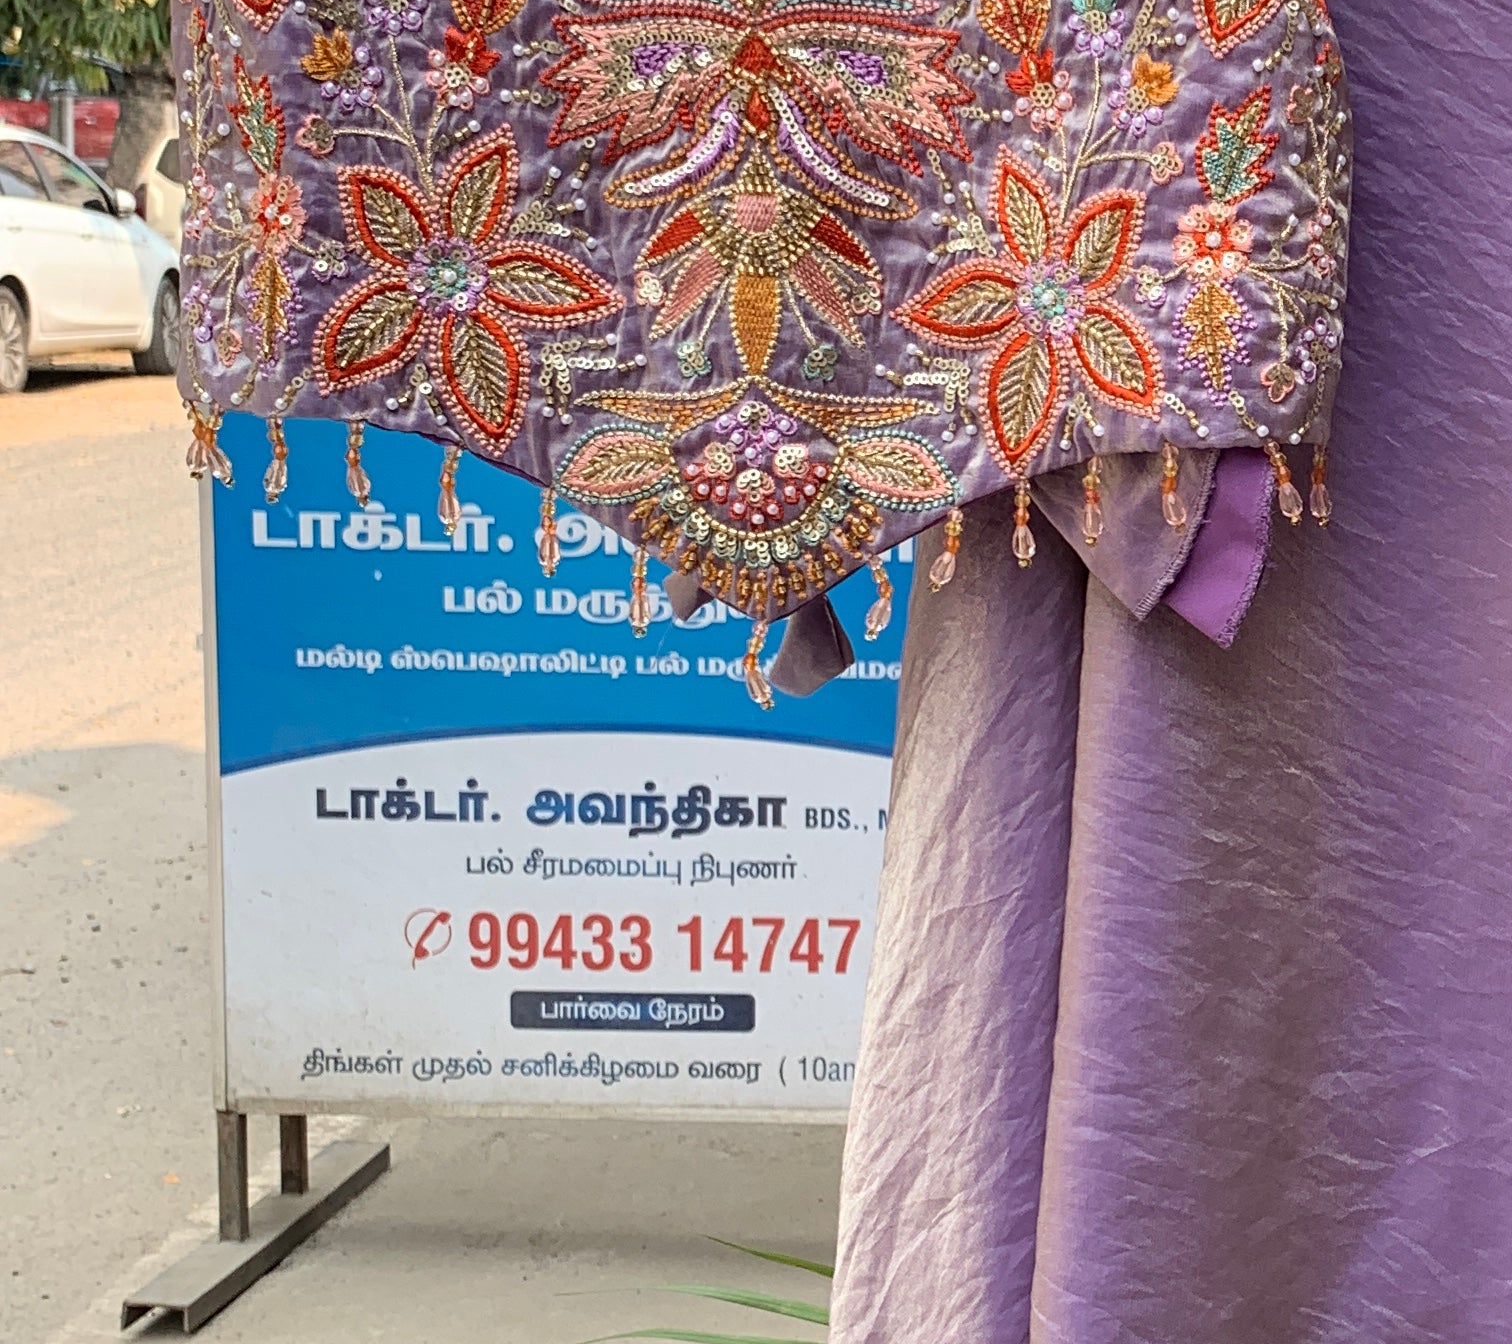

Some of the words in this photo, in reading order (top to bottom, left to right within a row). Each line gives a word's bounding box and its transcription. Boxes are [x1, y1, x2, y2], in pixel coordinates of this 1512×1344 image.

[443, 580, 523, 614] பல்
[296, 643, 383, 675] மல்டி
[636, 652, 690, 676] பல்
[316, 776, 502, 823] டாக்டர்.
[526, 781, 788, 839] அவந்திகா
[466, 847, 514, 875] பல்
[690, 853, 798, 887] நிபுணர்
[468, 911, 653, 972] 99433
[677, 914, 861, 975] 14747
[541, 995, 641, 1022] பார்வை
[649, 996, 725, 1029] நேரம்
[301, 1048, 403, 1080] திங்கள்
[412, 1050, 492, 1083] முதல்
[502, 1051, 679, 1086] சனிக்கிழமை
[689, 1058, 762, 1084] வரை
